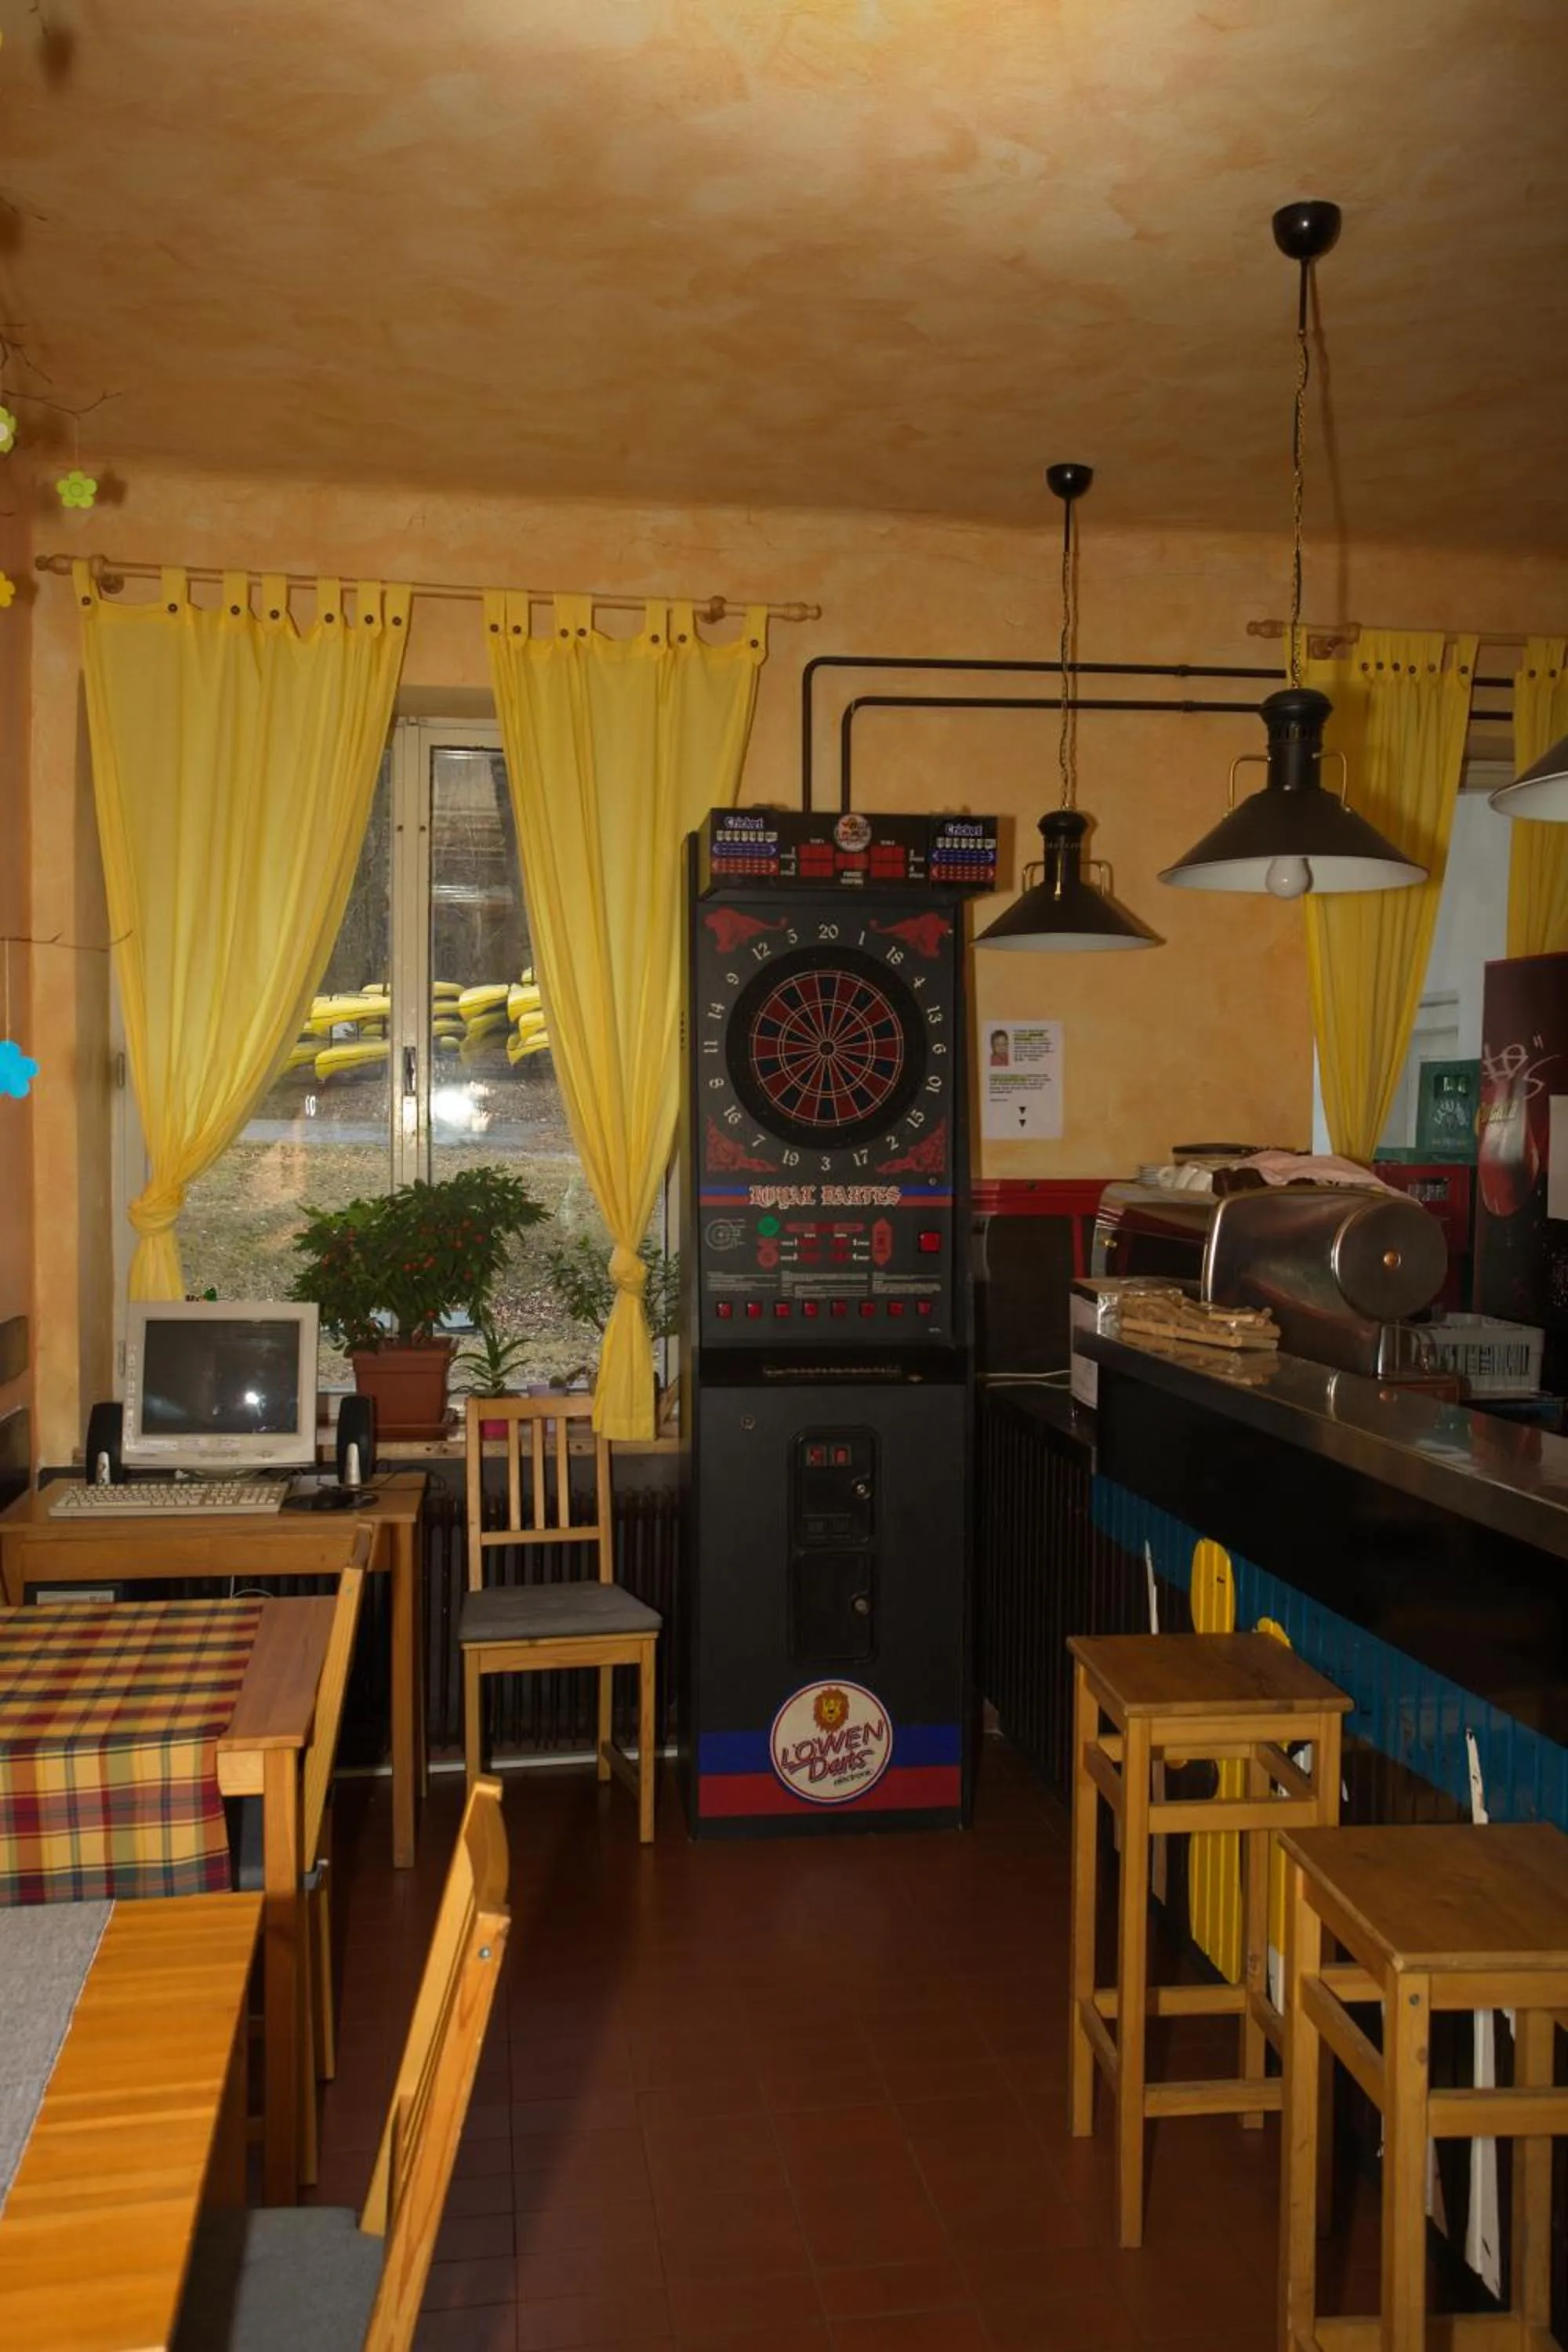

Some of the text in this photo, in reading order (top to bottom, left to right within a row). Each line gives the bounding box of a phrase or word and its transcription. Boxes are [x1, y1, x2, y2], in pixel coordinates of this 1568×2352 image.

[787, 928, 798, 944] 5
[818, 924, 839, 939] 20
[858, 931, 866, 946] 1
[752, 942, 771, 961] 12
[886, 946, 904, 965] 18
[913, 976, 927, 989] 4
[707, 1003, 725, 1019] 14
[926, 1004, 943, 1024] 13
[703, 1040, 719, 1053] 11
[925, 1076, 942, 1093] 10
[723, 1105, 742, 1124] 16
[906, 1109, 925, 1128] 15
[752, 1134, 766, 1148] 7
[886, 1135, 899, 1151] 2
[782, 1149, 800, 1167] 19
[821, 1156, 831, 1171] 3
[852, 1149, 869, 1167] 17
[808, 1749, 874, 1784] Darts
